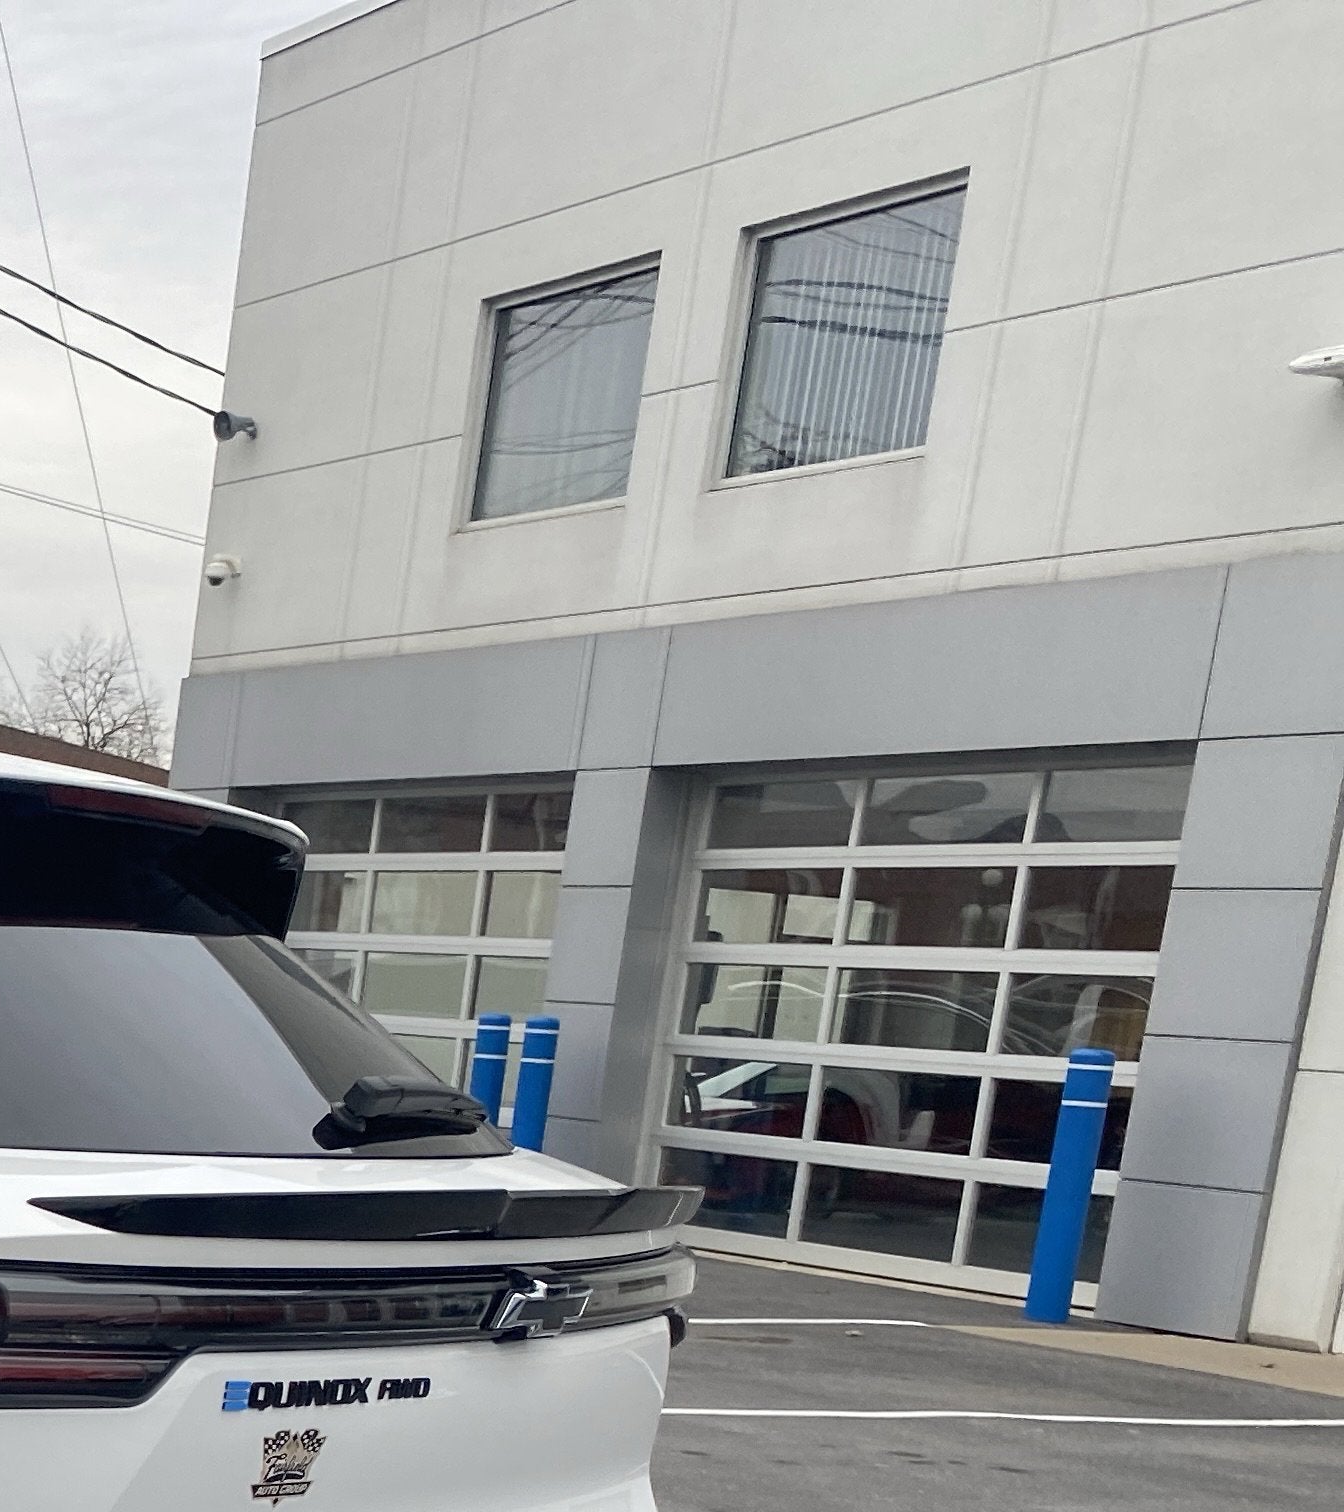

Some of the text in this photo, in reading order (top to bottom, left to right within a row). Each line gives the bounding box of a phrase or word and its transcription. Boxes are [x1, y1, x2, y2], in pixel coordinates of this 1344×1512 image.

[221, 1377, 431, 1411] EQUINOX AWD
[255, 1485, 278, 1496] AUTO
